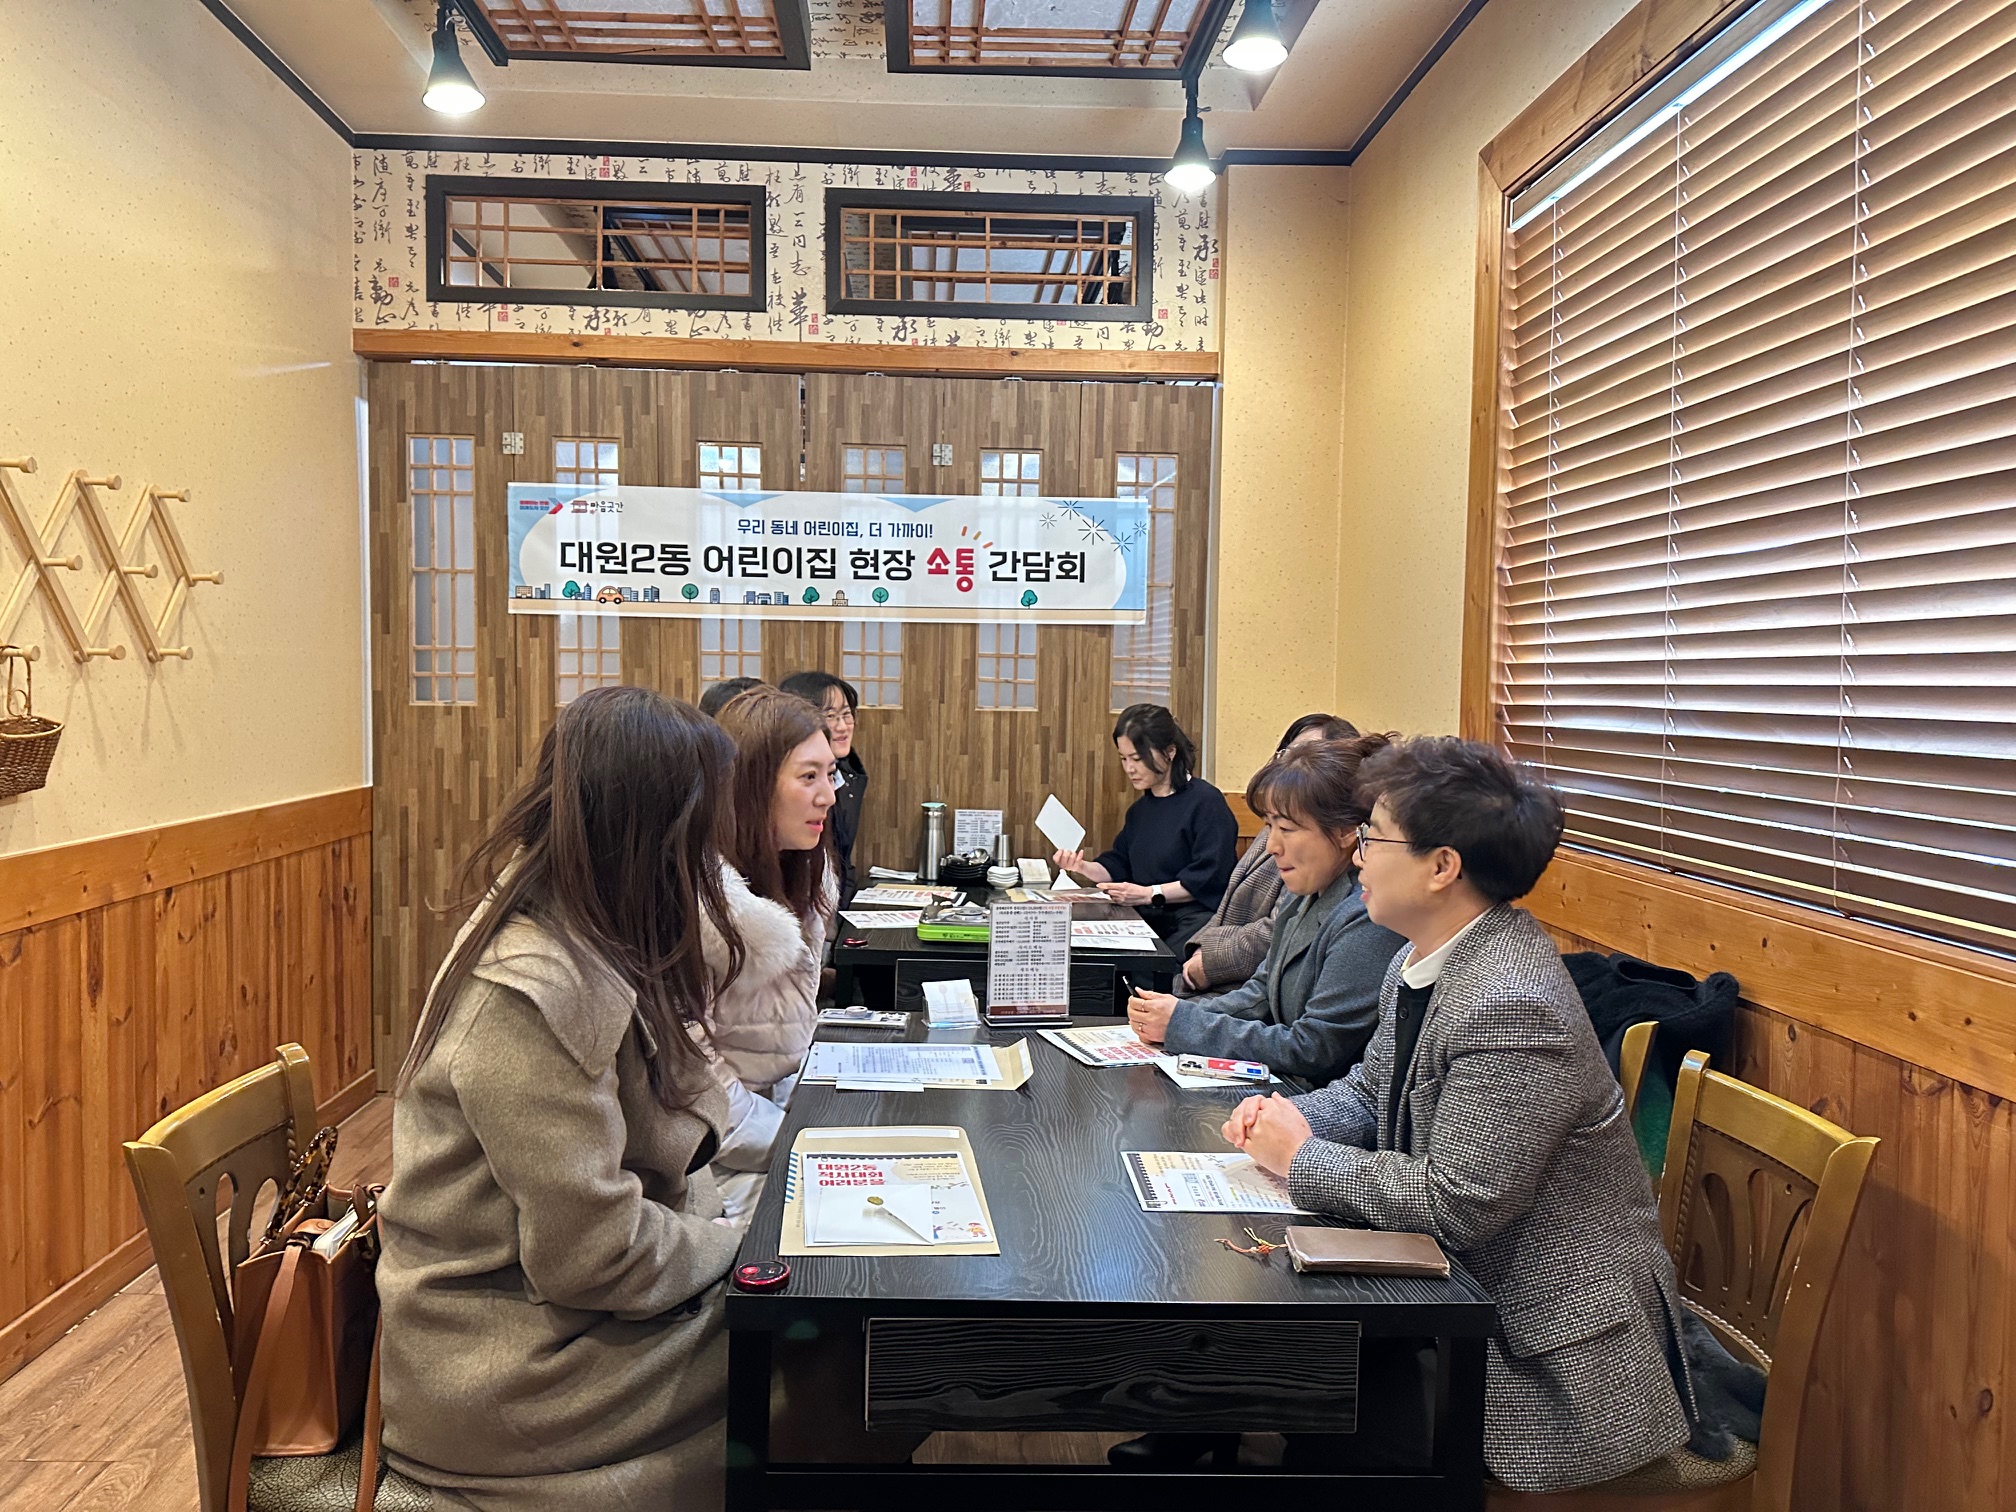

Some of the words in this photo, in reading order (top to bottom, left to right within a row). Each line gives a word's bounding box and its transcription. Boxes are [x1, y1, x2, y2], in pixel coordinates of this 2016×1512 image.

[737, 518, 765, 535] 우리
[770, 520, 799, 536] 동네
[803, 520, 864, 538] 어린이집,
[869, 522, 882, 538] 더
[887, 522, 934, 539] 가까이!
[559, 541, 692, 576] 대원2동
[703, 544, 837, 580] 어린이집
[849, 547, 916, 582] 현장
[926, 547, 975, 593] 소통
[988, 550, 1086, 583] 간담회
[817, 1163, 878, 1171] 대원2동
